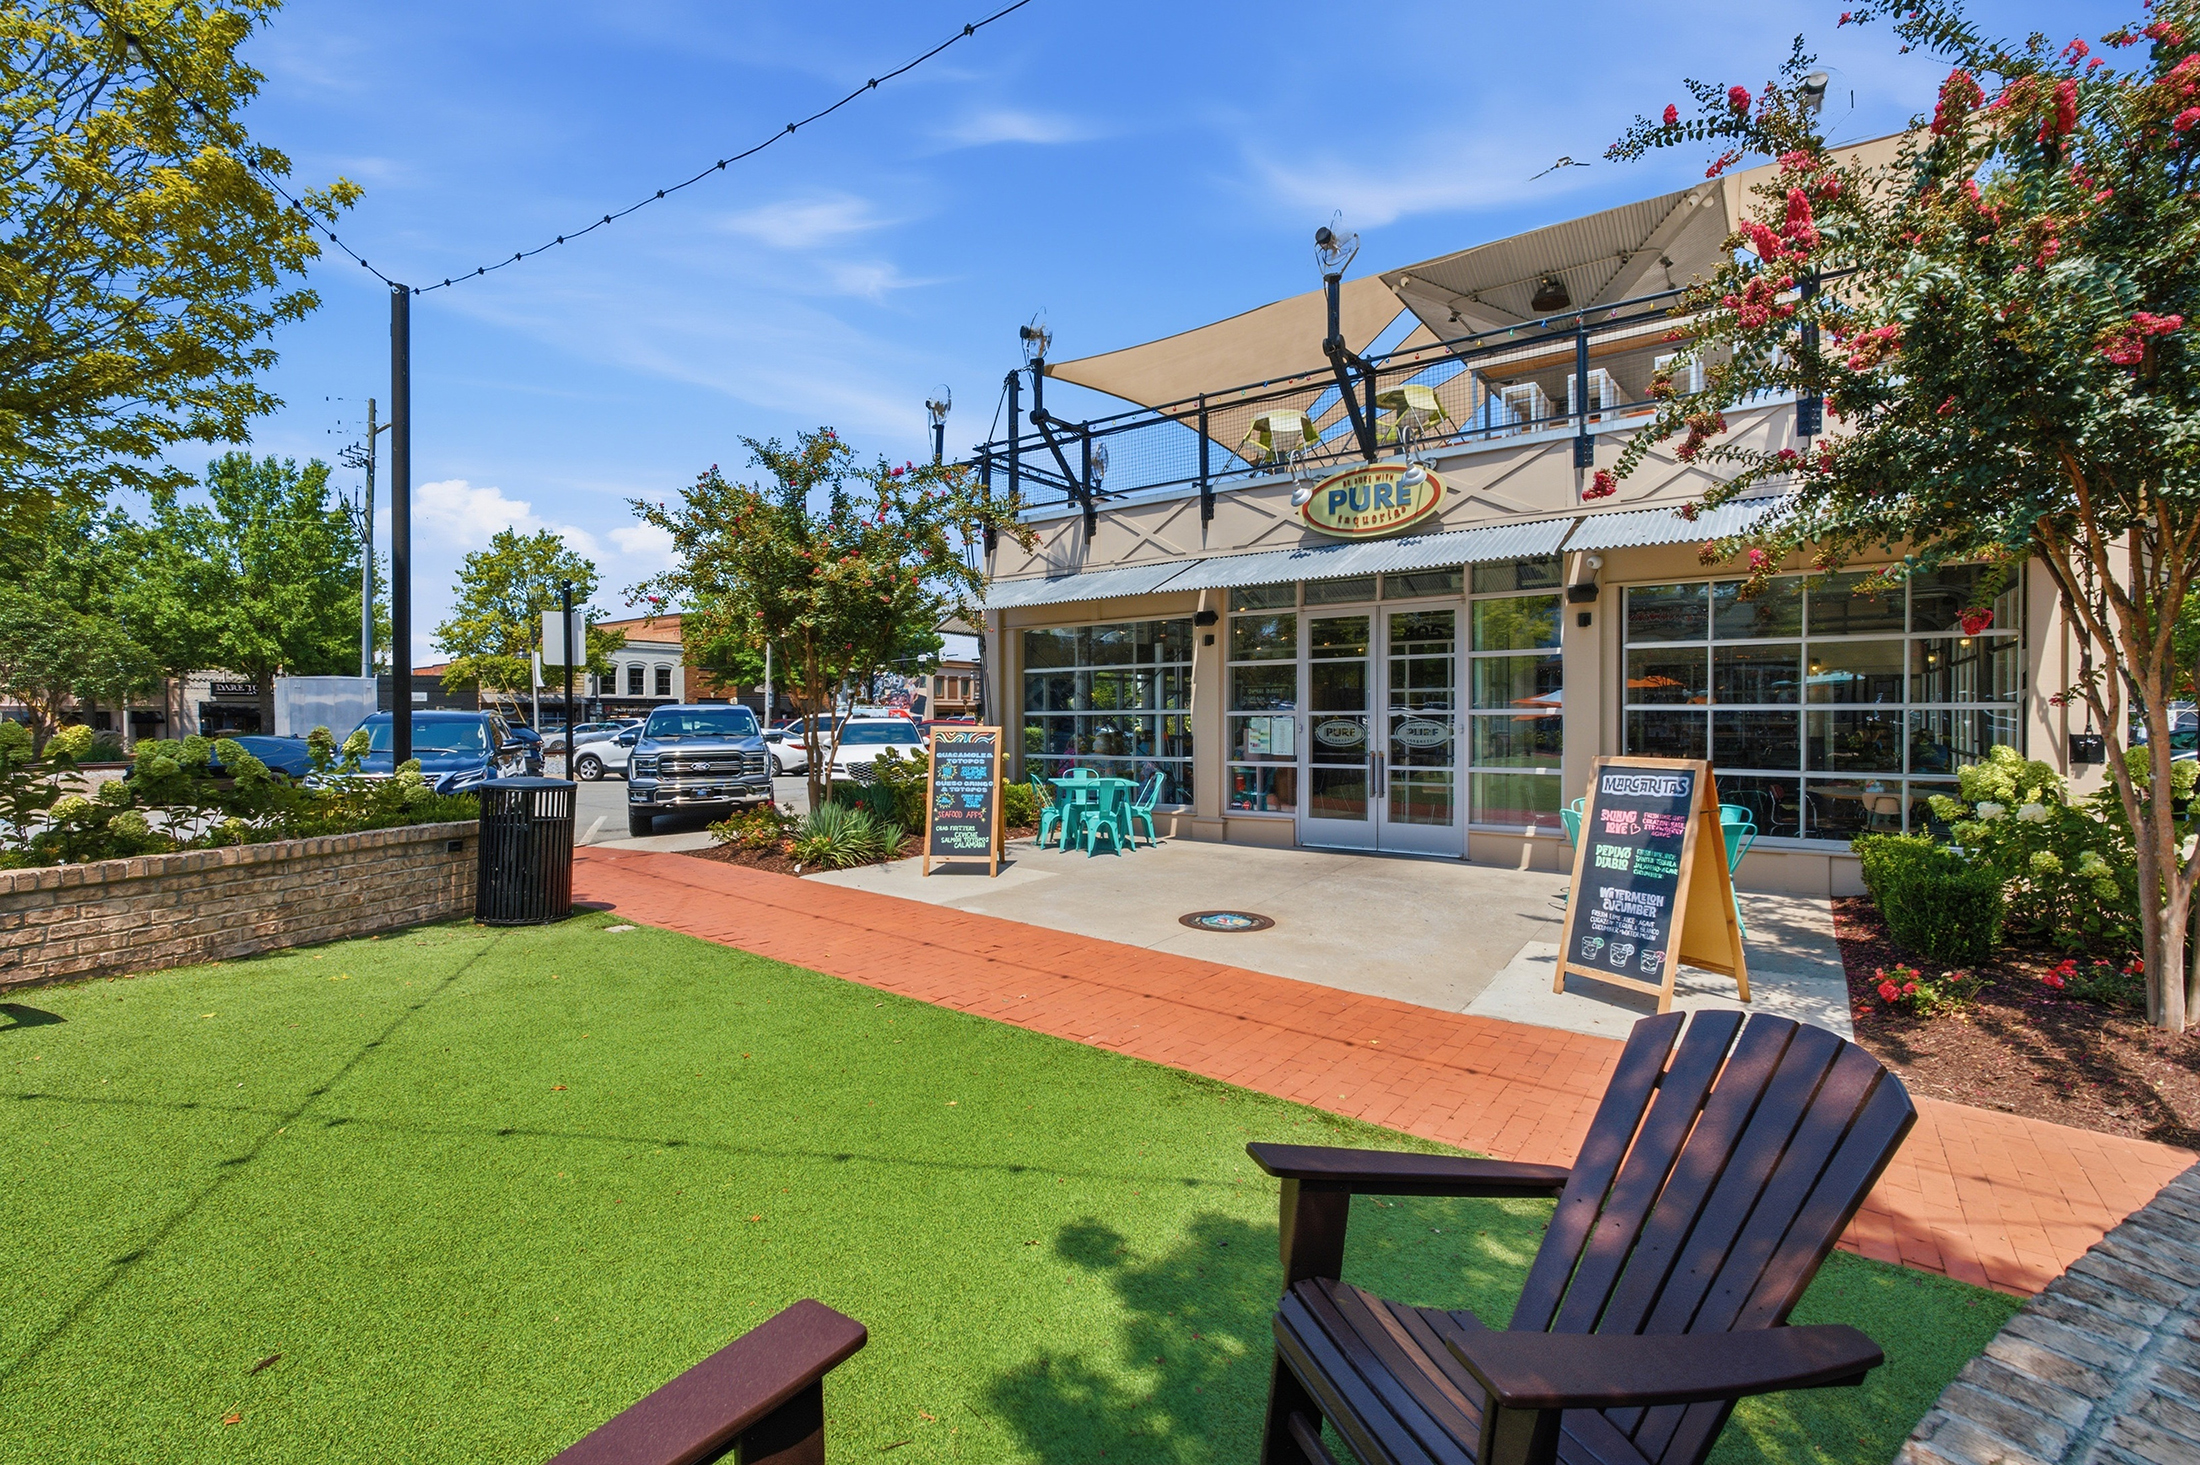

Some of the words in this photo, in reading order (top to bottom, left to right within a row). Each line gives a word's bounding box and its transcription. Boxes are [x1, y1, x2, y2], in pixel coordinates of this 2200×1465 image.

[1328, 480, 1411, 515] PURE
[1326, 727, 1356, 737] PURE
[1603, 775, 1689, 796] MARGARITAS
[1605, 821, 1628, 834] LOVE
[1595, 844, 1632, 859] PEPINO
[1595, 855, 1629, 870] DIABLO
[1599, 886, 1664, 907] WATERMELON
[1602, 898, 1657, 918] CUCUMBER
